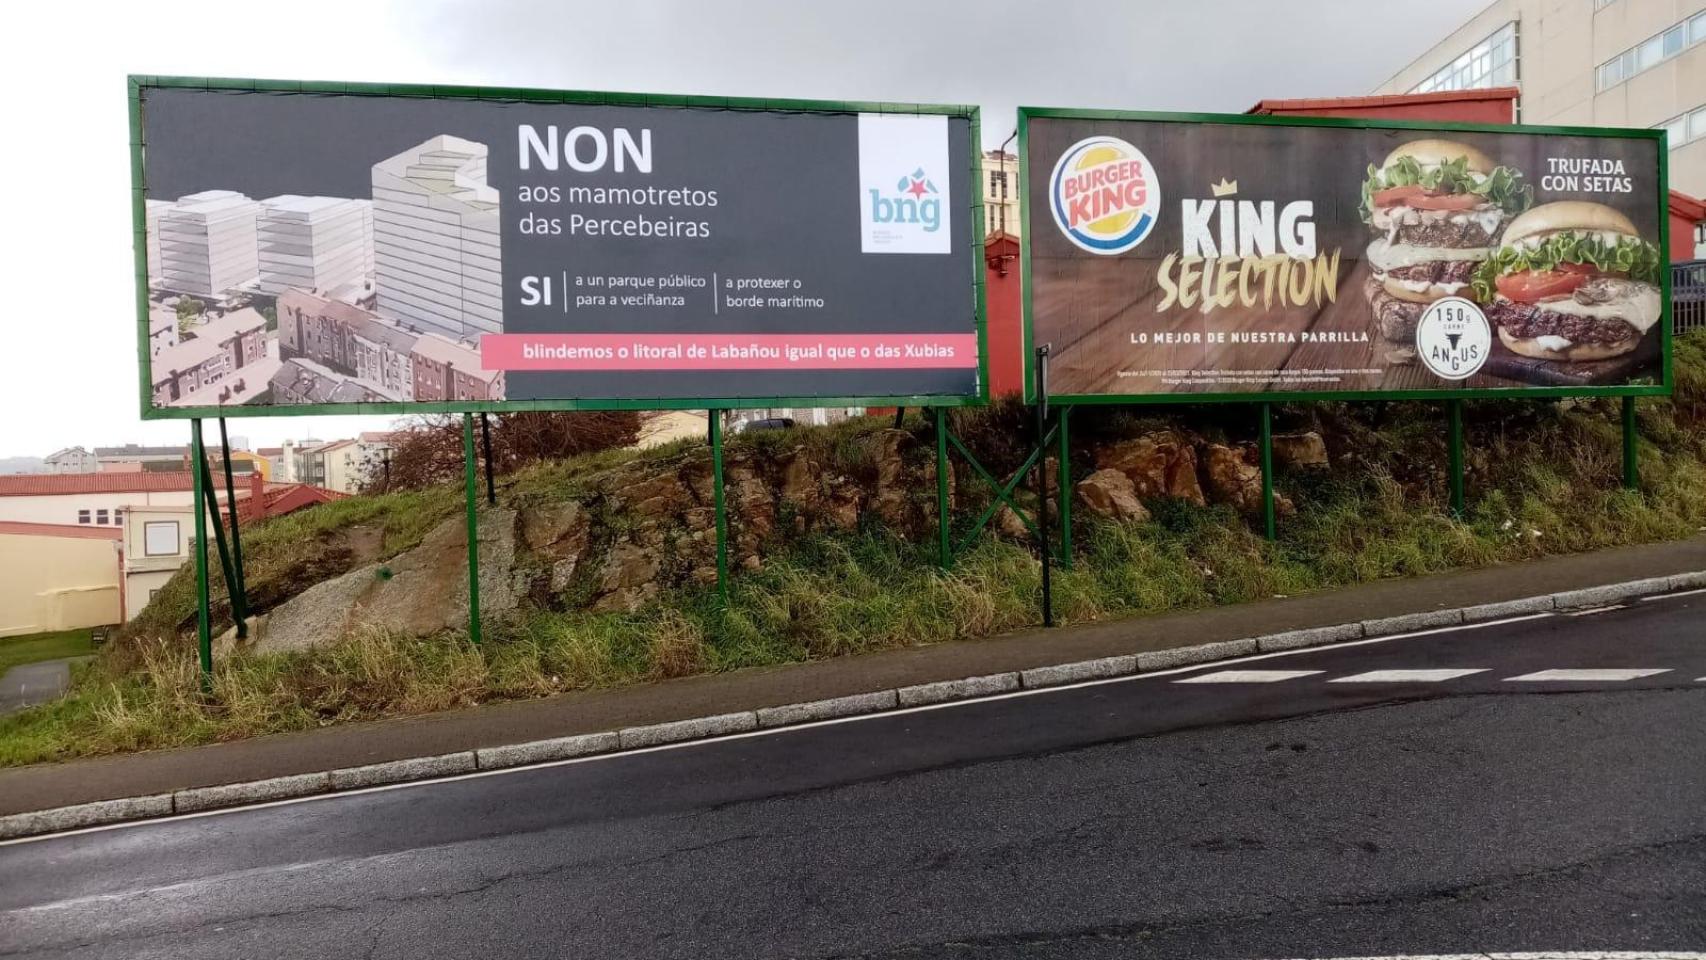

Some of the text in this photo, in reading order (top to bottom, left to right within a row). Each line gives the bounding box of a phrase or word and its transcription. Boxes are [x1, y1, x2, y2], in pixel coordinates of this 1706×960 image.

[518, 124, 652, 173] NON
[1547, 157, 1626, 175] TRUFADA
[1065, 161, 1142, 199] BURGER
[1541, 175, 1632, 193] CON SETAS
[518, 185, 718, 207] aos mamotretos
[1068, 180, 1147, 226] KING
[868, 188, 941, 232] bng
[519, 212, 710, 237] das Percebeiras
[1182, 198, 1317, 260] KING
[520, 276, 552, 306] SI
[575, 273, 706, 289] a un parque público
[725, 278, 802, 292] a protexer o
[1156, 247, 1341, 314] SELECTION
[576, 292, 685, 309] para a veciñanza
[726, 294, 764, 308] borde
[1131, 331, 1369, 344] LO MEJOR DE NUESTRA PARRILLA
[523, 343, 955, 361] blindemos o litoral de Labañou igual que o das Xubias
[1432, 344, 1478, 371] ANGUS
